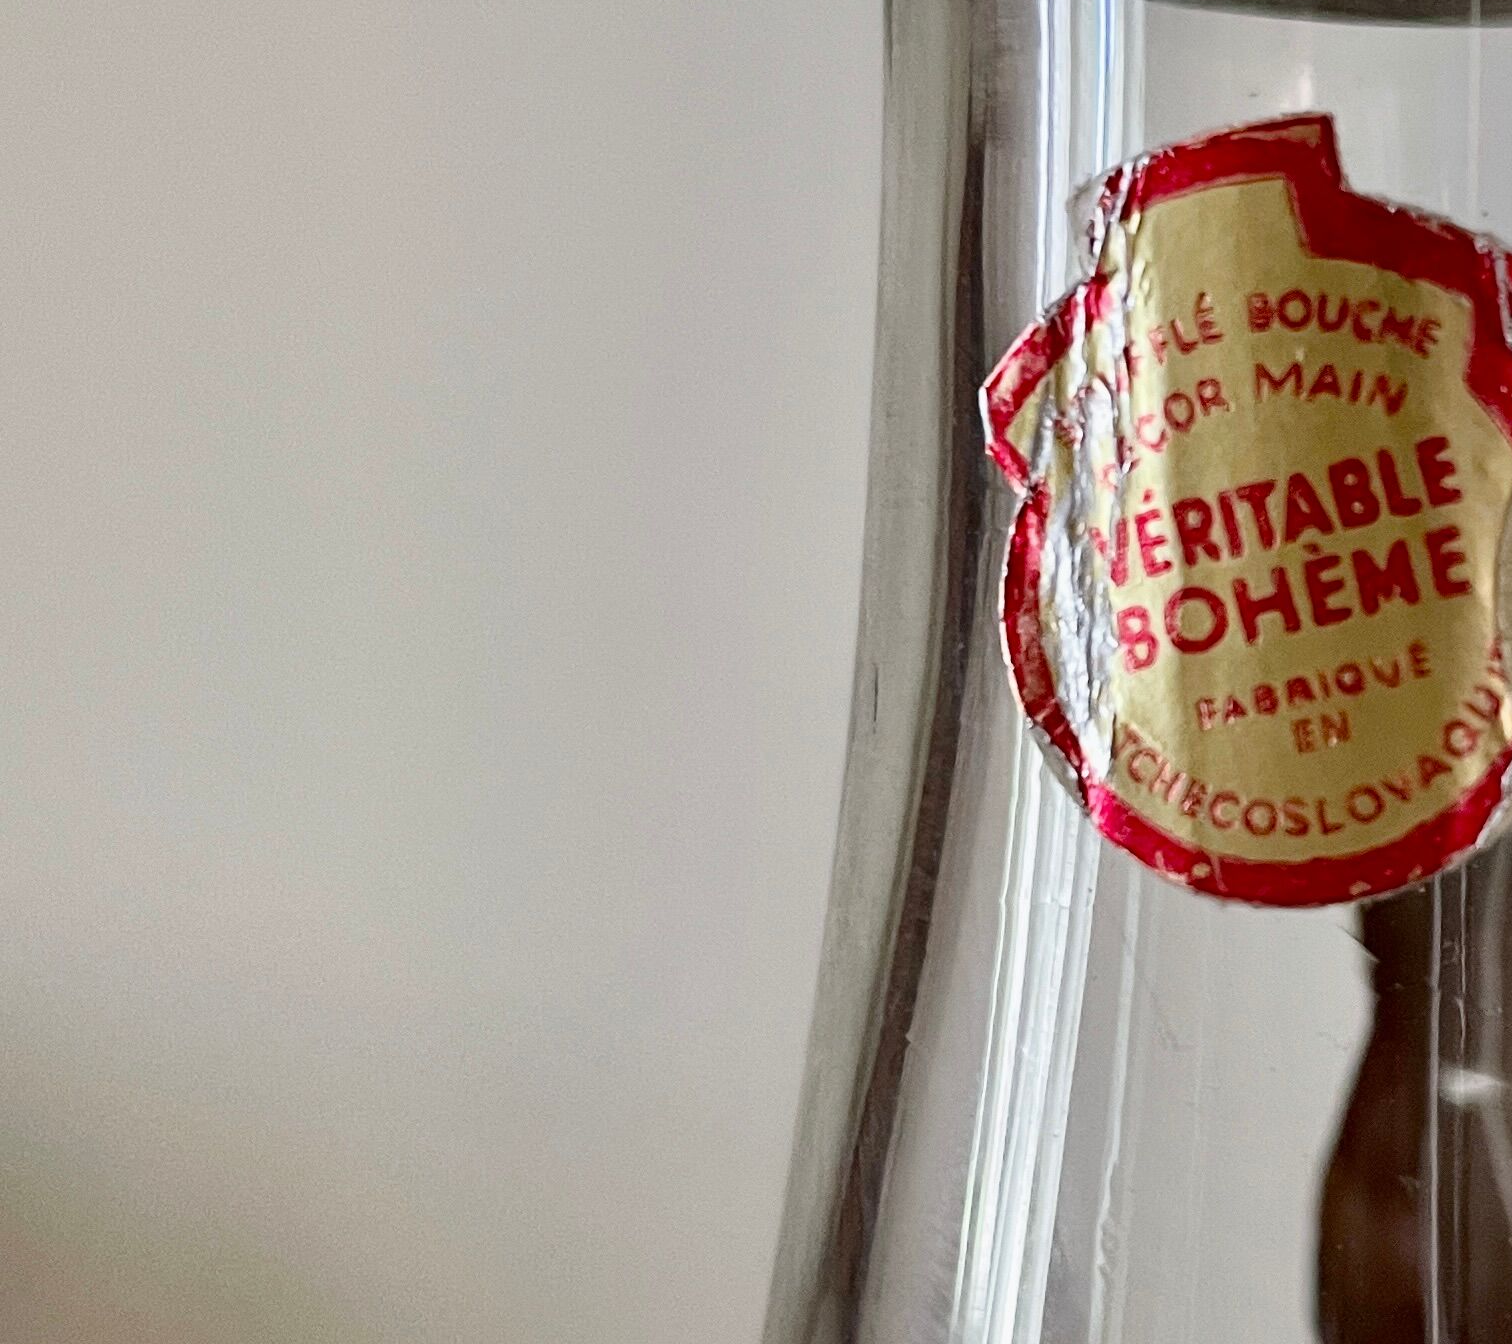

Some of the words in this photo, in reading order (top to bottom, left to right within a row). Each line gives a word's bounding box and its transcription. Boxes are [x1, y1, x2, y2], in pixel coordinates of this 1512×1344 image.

[1254, 361, 1409, 417] MAIN
[1089, 436, 1462, 587] VÉRITABLE
[1116, 525, 1472, 674] BOHÈME
[1291, 709, 1352, 754] EN
